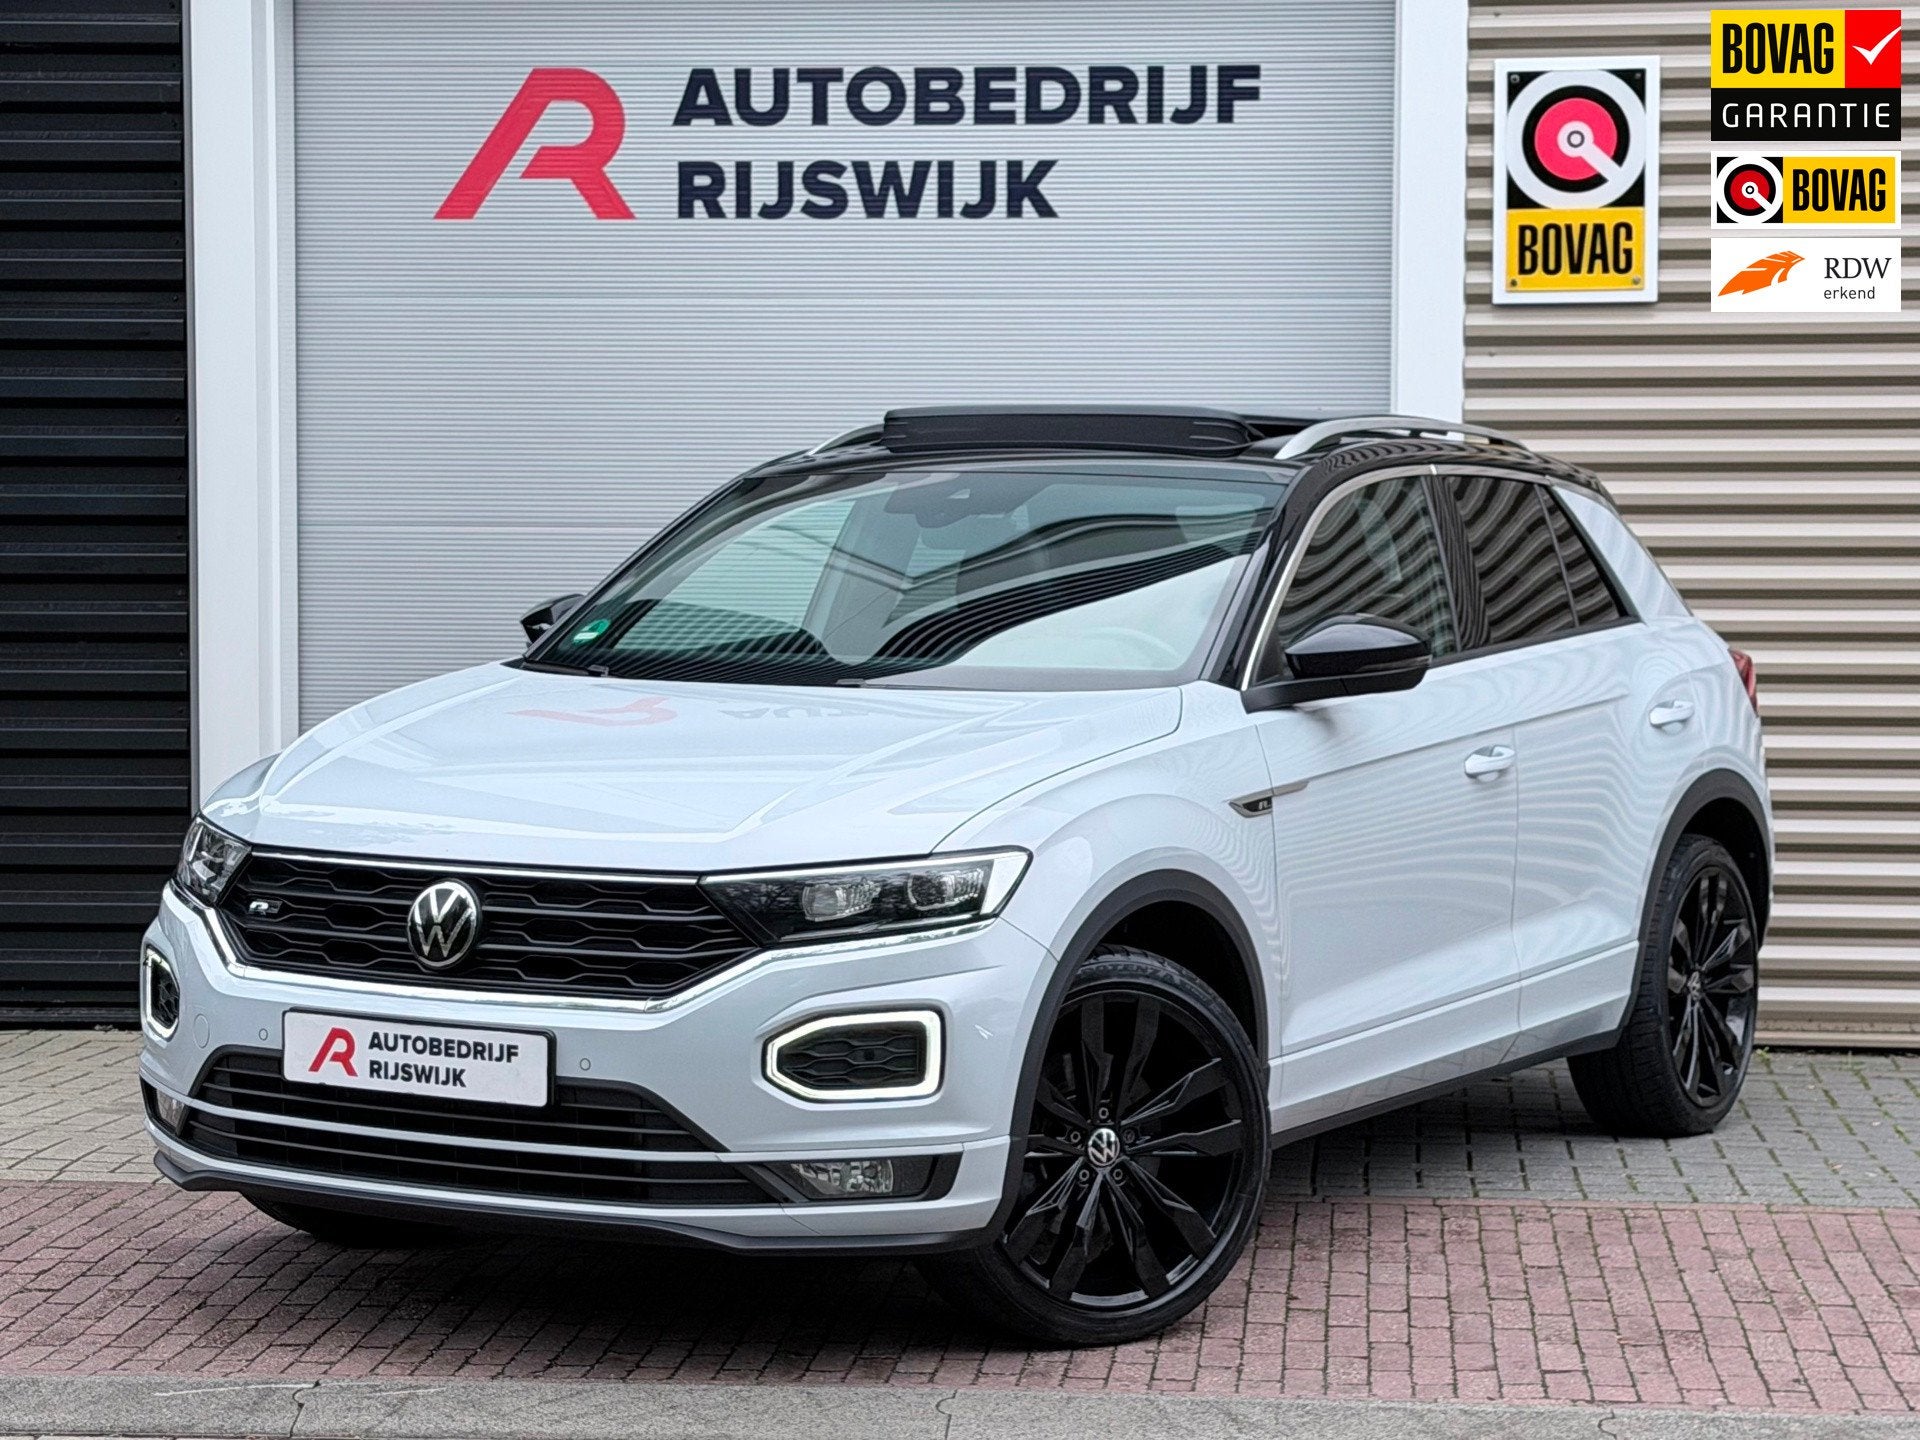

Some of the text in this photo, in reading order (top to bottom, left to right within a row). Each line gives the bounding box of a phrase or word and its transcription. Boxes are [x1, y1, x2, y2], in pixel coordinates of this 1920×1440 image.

[672, 65, 1261, 126] AUTOBEDRIJF
[678, 159, 1059, 220] RIJSWIJK
[1518, 221, 1633, 276] BOVAG
[368, 1031, 520, 1063] AUTOBEDRIJF
[369, 1059, 467, 1088] RIJSWIJK
